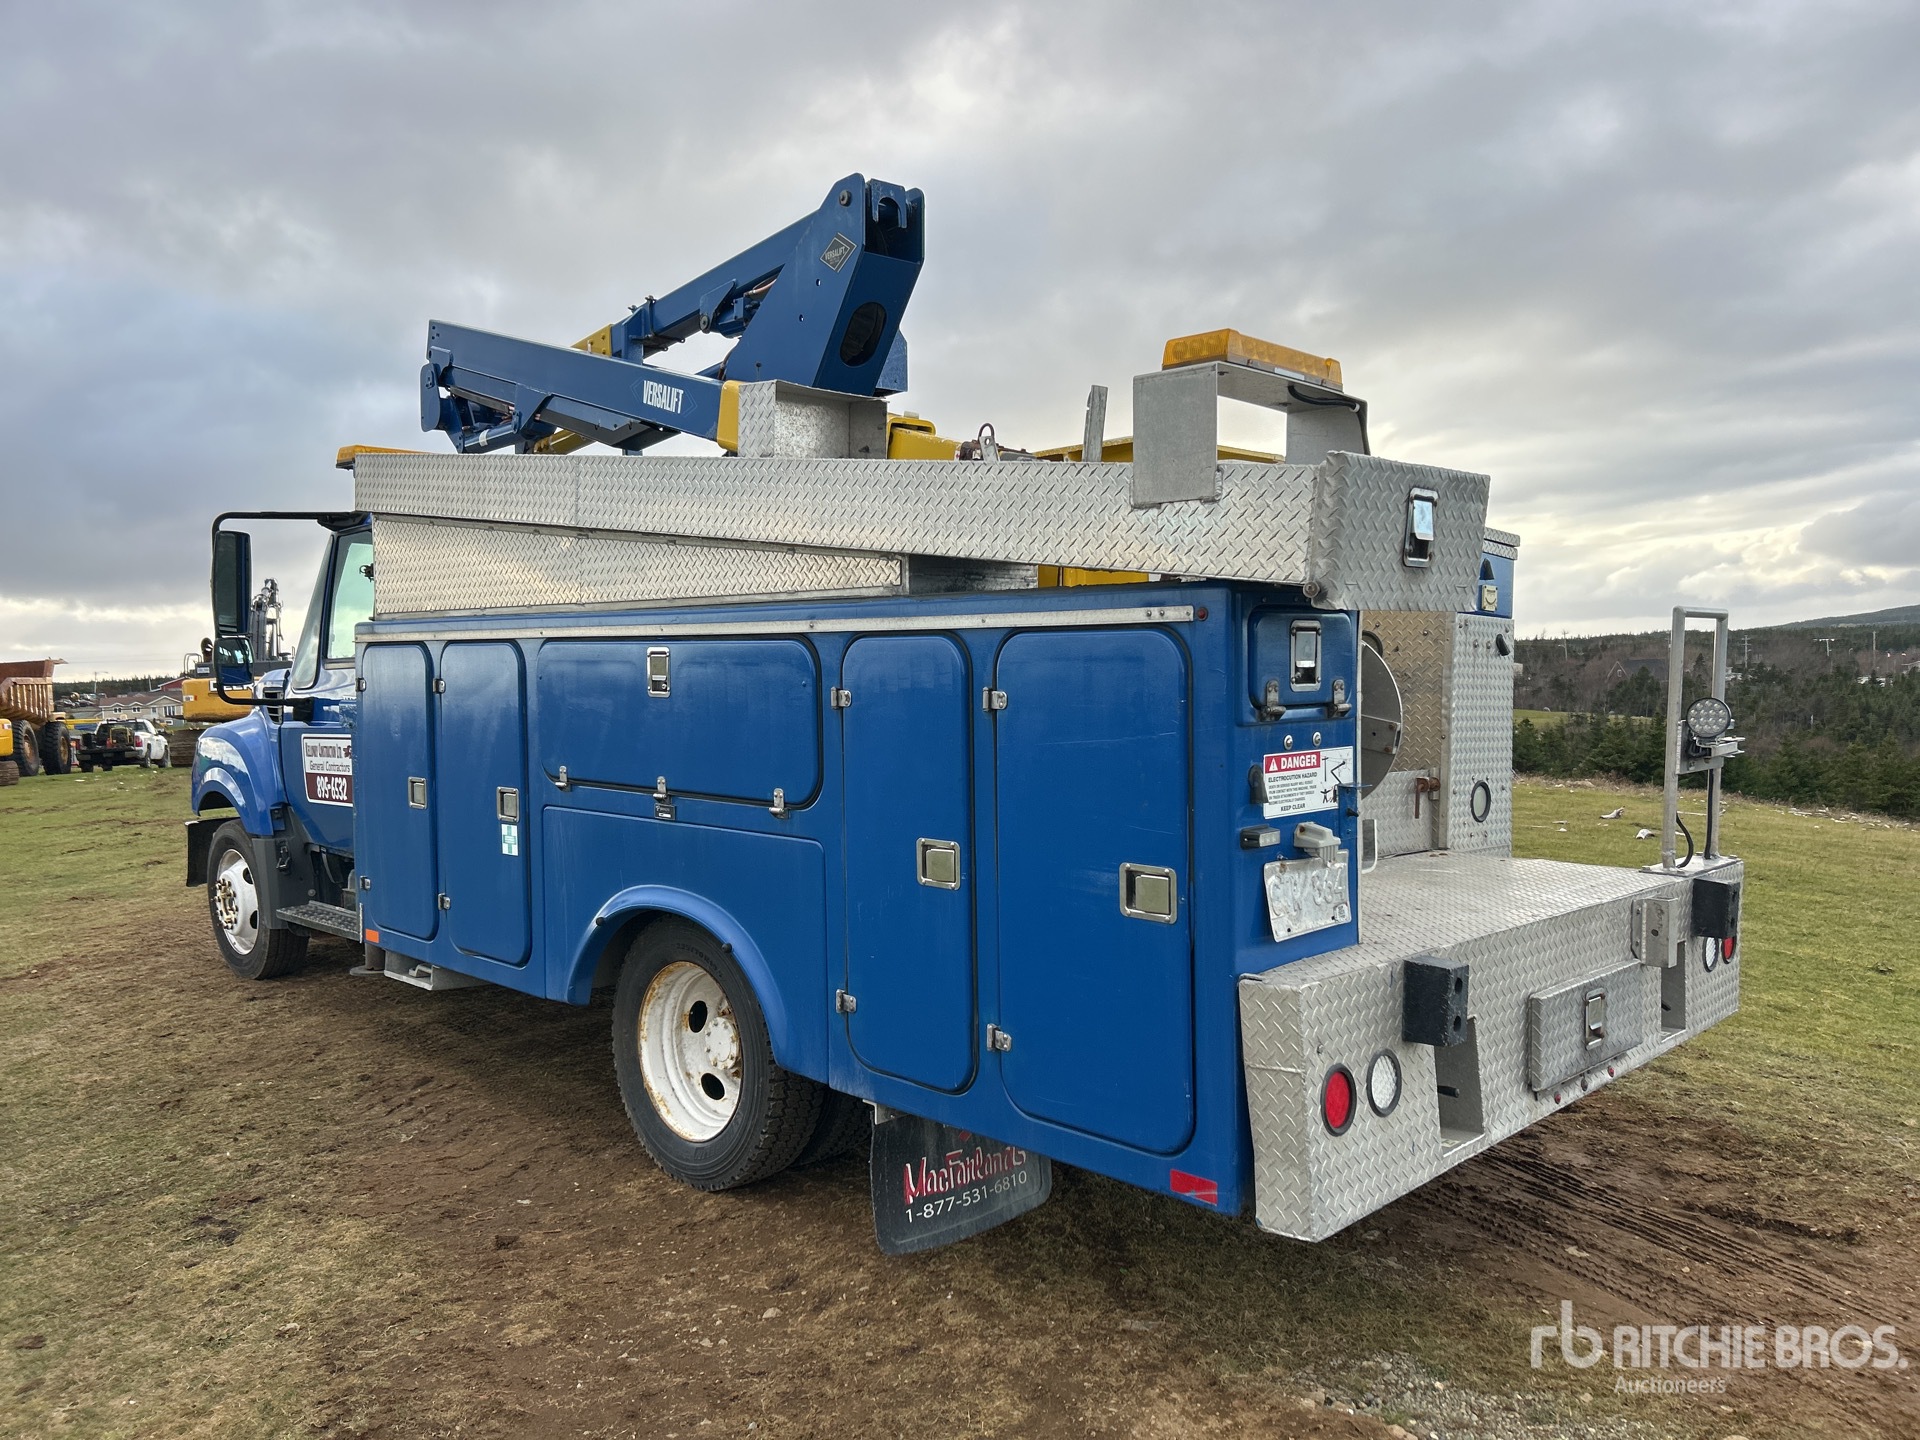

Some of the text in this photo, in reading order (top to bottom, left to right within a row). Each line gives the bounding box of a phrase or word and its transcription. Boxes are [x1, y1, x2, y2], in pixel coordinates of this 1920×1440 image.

[643, 380, 684, 414] VERSALIFT
[1280, 754, 1317, 770] DANGER
[316, 775, 348, 801] 895-6532
[1268, 774, 1301, 783] ELECTROCUTION
[905, 1170, 1027, 1223] 1-877-531-6810
